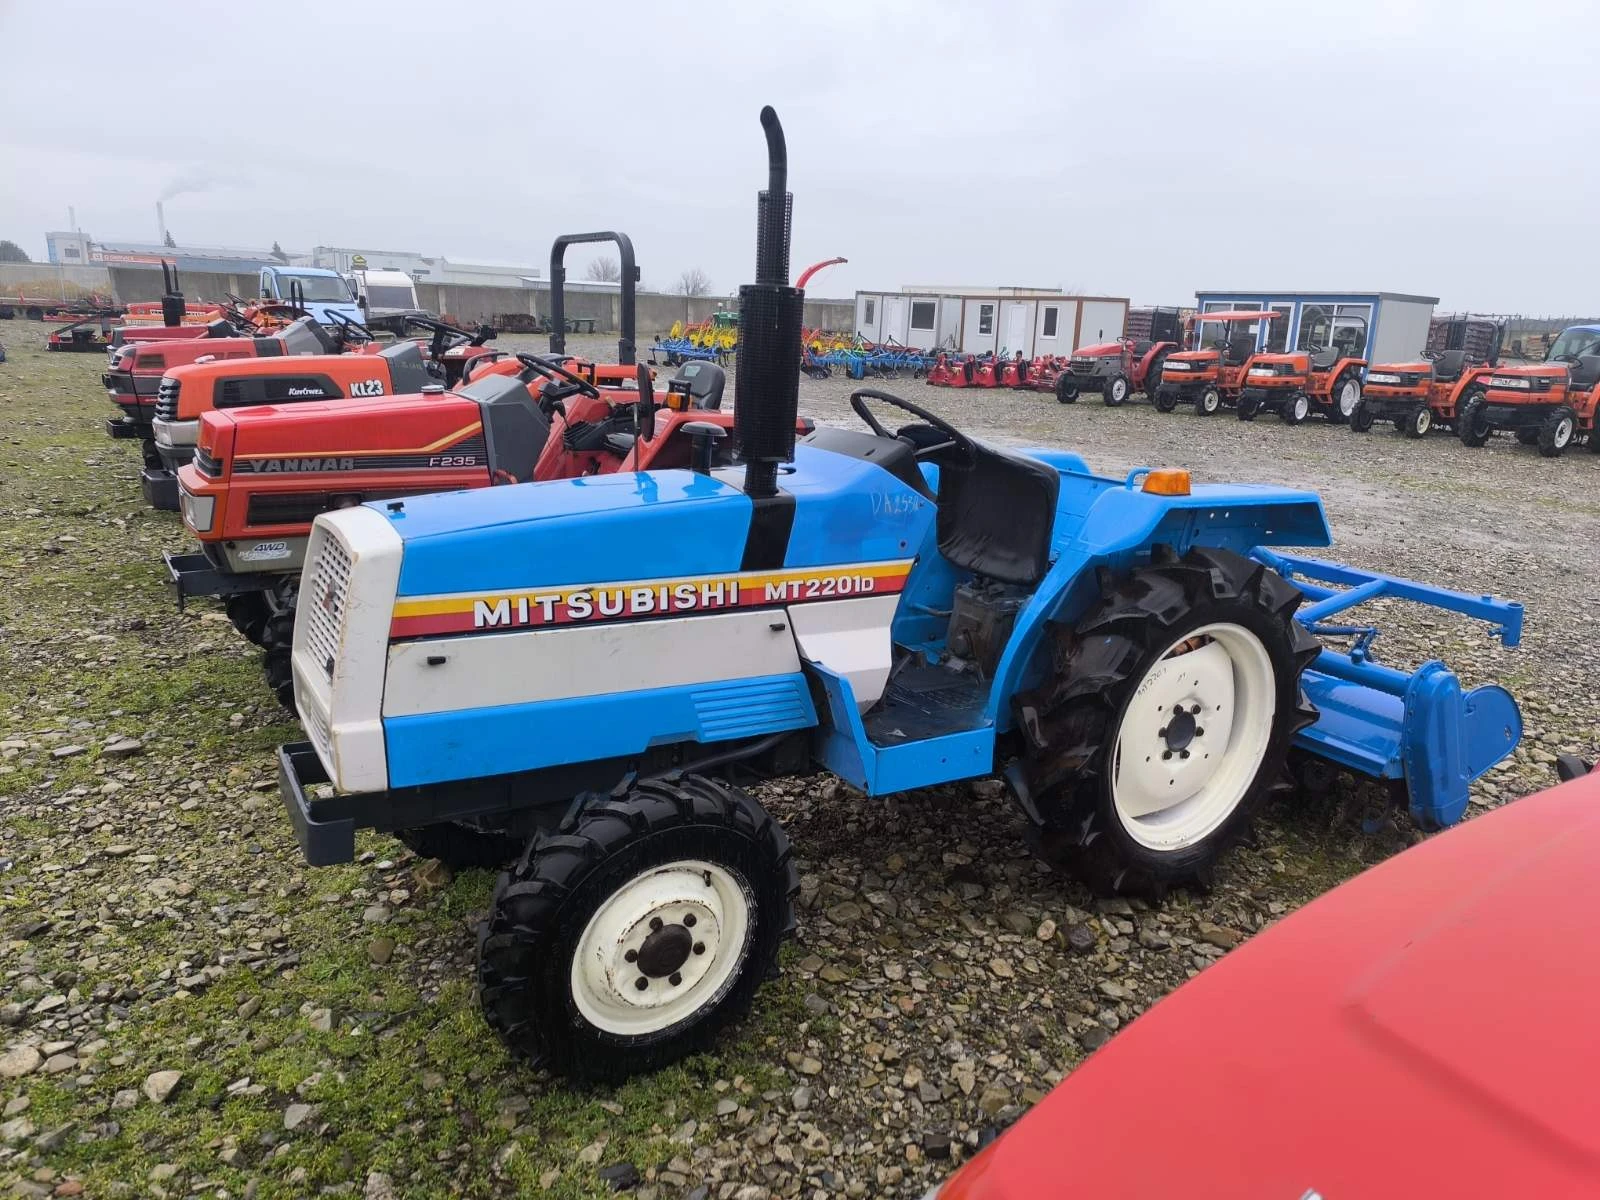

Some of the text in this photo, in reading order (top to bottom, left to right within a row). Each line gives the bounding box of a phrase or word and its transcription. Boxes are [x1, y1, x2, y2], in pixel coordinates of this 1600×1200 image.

[350, 379, 384, 397] KL23
[251, 458, 354, 473] YANMAR
[429, 456, 476, 467] F235
[254, 542, 285, 552] 4WD
[473, 575, 874, 627] MITSUBISHI MT2201D
